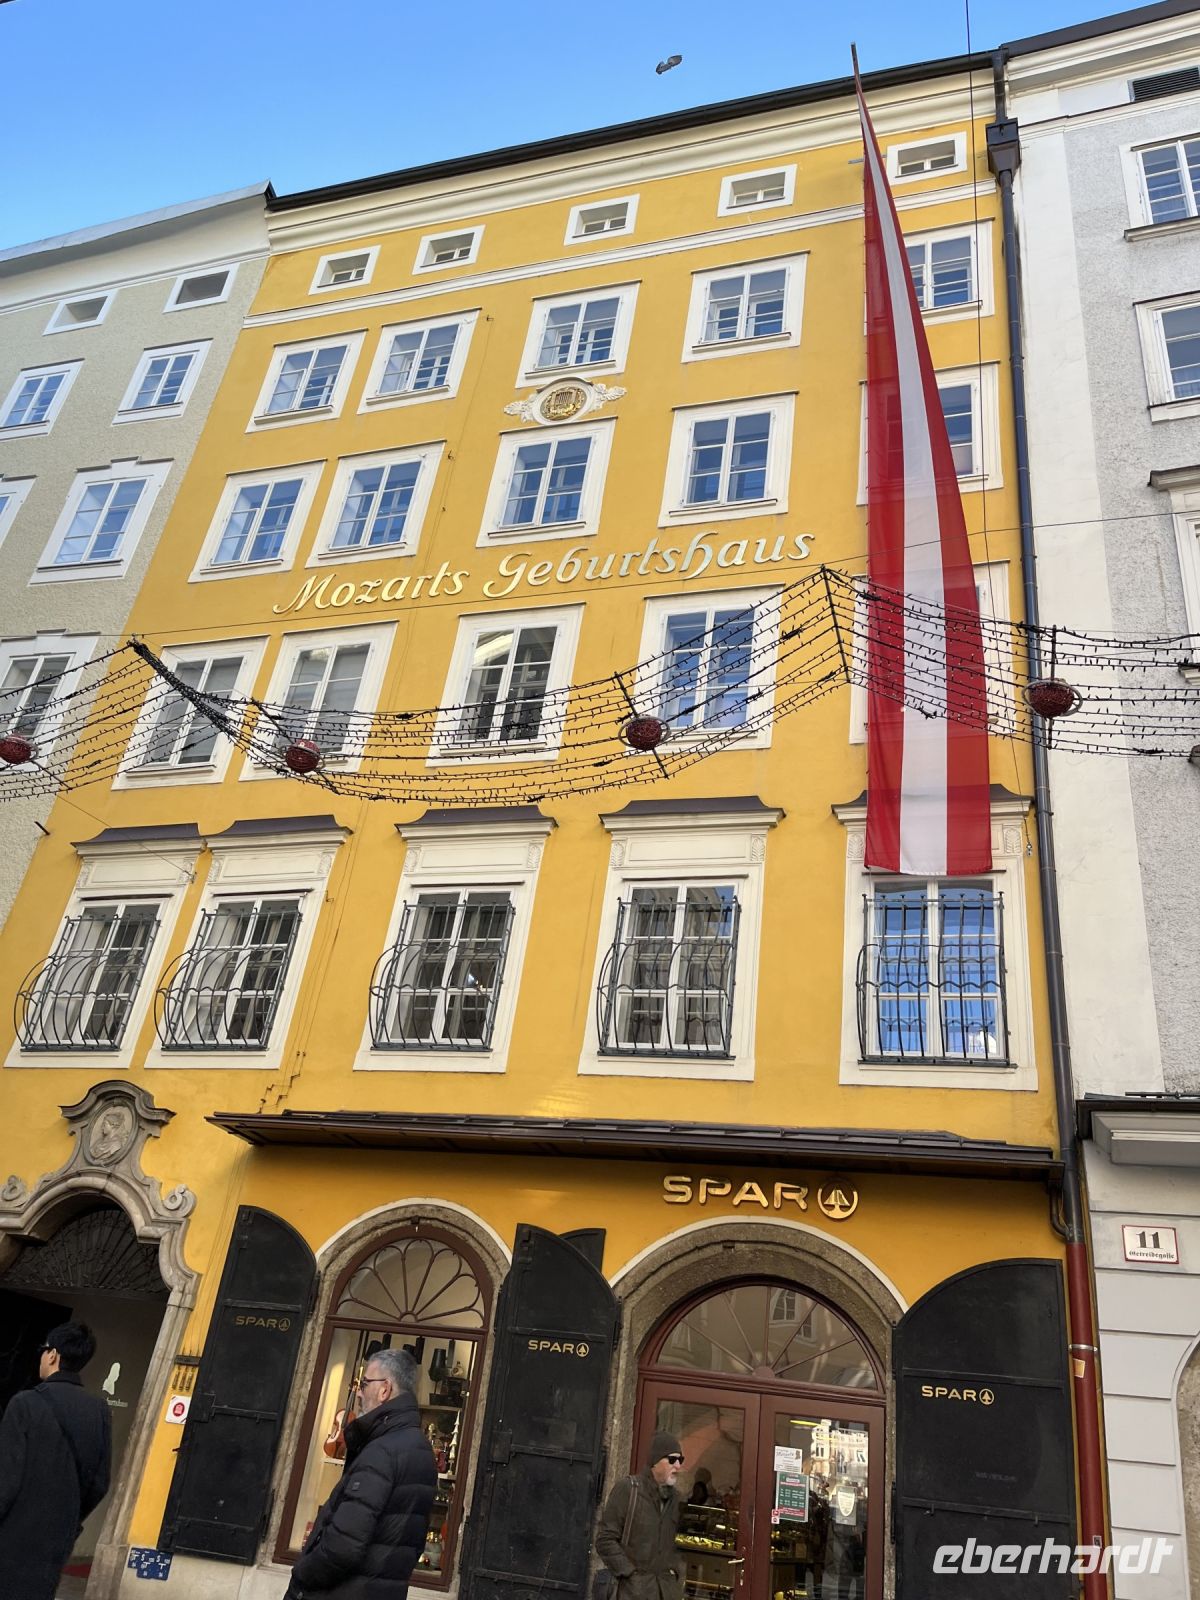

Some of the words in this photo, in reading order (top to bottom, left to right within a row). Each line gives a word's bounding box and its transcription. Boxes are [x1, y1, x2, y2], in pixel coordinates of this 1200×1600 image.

[273, 560, 470, 614] Mozarts
[482, 531, 815, 598] Geburtshaus
[663, 1176, 808, 1210] SPAR
[1136, 1231, 1164, 1249] 11
[235, 1315, 278, 1329] SPAR
[528, 1340, 575, 1354] SPAR
[921, 1385, 977, 1402] SPAR
